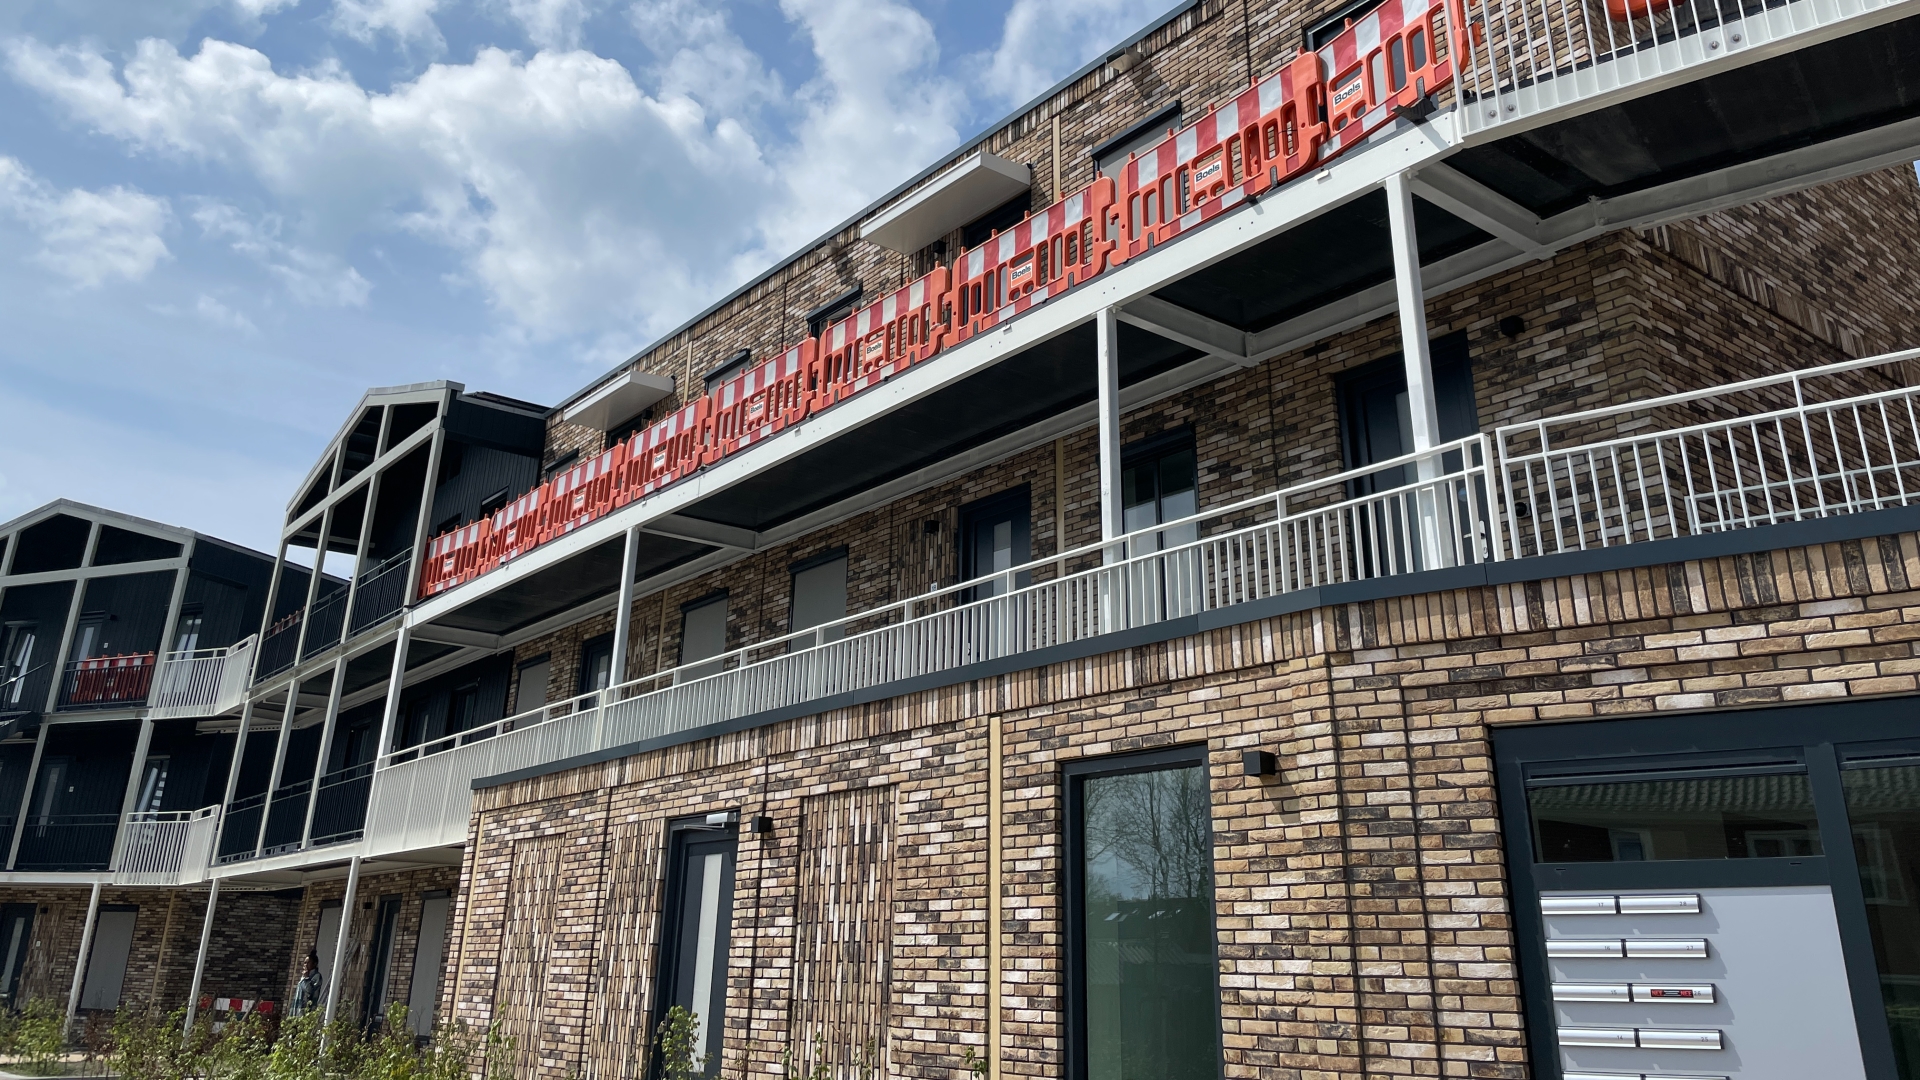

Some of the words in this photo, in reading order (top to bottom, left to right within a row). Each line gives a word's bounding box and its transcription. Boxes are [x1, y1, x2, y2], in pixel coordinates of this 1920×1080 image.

[1334, 82, 1361, 105] Boels
[1195, 163, 1220, 182] Boels
[1012, 265, 1031, 280] Boels
